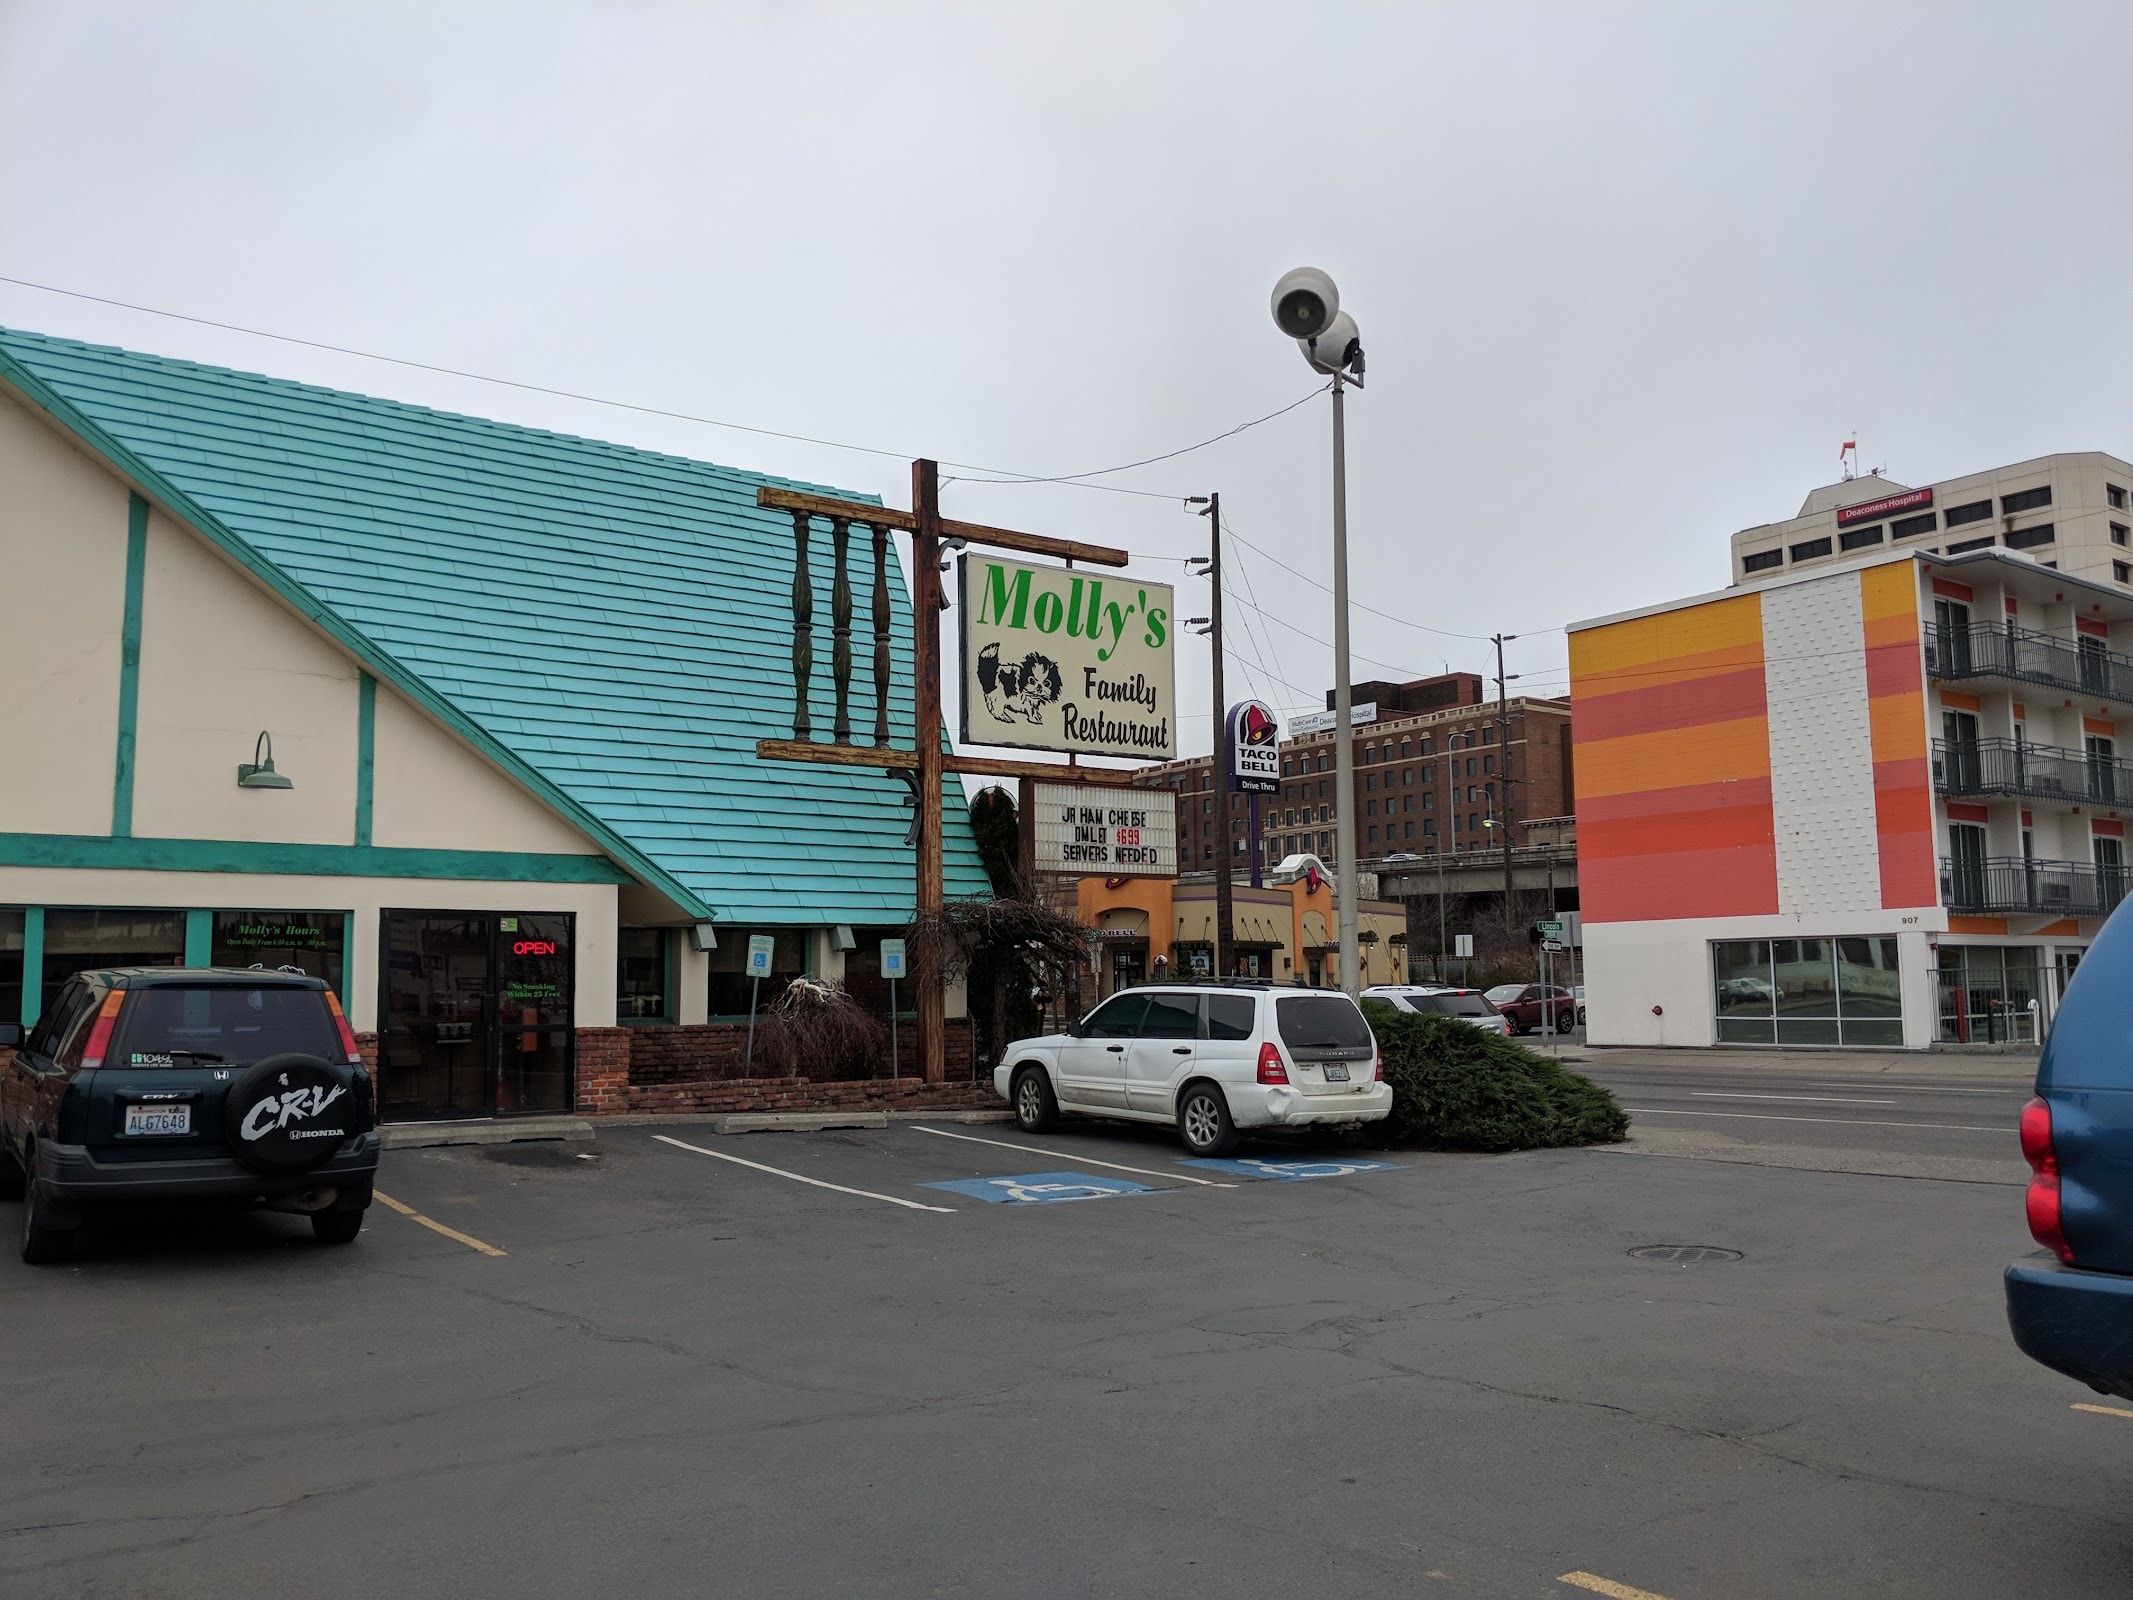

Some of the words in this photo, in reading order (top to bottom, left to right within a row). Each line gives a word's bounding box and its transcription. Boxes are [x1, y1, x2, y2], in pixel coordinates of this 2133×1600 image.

[1846, 504, 1887, 518] Deaconess
[1889, 493, 1922, 507] Hospital
[976, 563, 1167, 662] Molly's
[1083, 666, 1157, 714] Family
[1061, 702, 1169, 750] Restaurant
[1238, 748, 1277, 760] TACO
[1241, 760, 1278, 773] BELL
[1242, 781, 1259, 790] Drive
[1260, 782, 1276, 791] Thru
[1080, 807, 1103, 826] HAM
[1108, 809, 1146, 828] CHEESE
[1063, 844, 1108, 863] SERVERS
[1542, 922, 1560, 930] Lincoln
[1901, 916, 1919, 925] 907
[238, 924, 281, 937] Molly's
[285, 925, 321, 936] Hours
[513, 942, 555, 955] OPEN
[523, 983, 556, 991] Smoking
[241, 1083, 347, 1141] CR-V
[130, 1114, 186, 1131] ALG7648
[300, 1129, 345, 1138] HONDA
